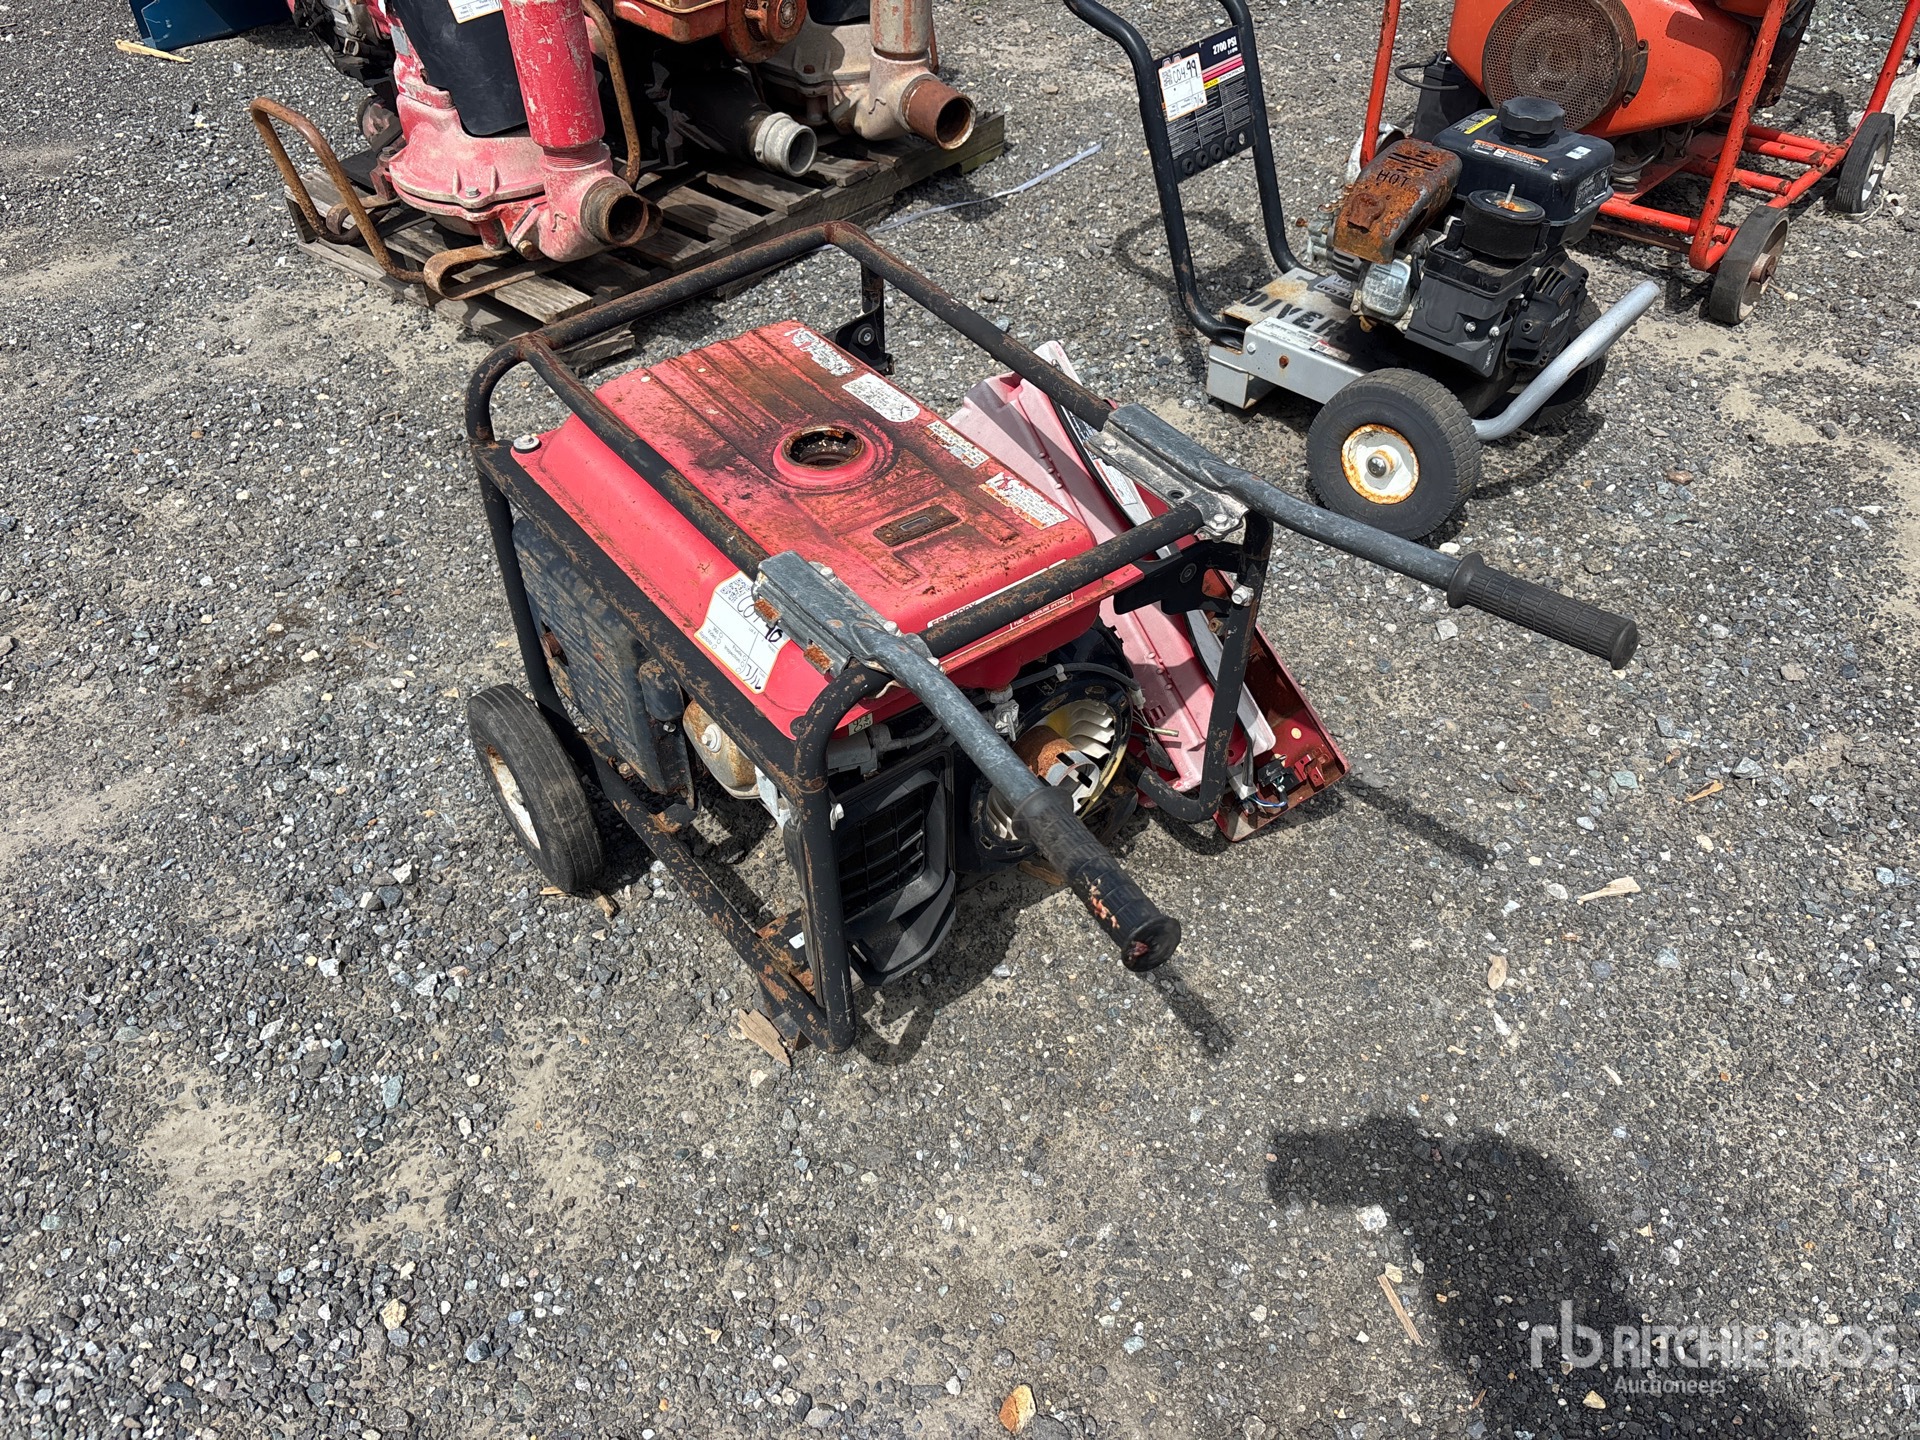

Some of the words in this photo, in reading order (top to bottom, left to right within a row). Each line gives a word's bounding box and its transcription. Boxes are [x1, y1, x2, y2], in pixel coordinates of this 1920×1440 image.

[1212, 41, 1227, 55] 2700
[1227, 36, 1238, 48] PSI
[1376, 169, 1411, 188] HOT
[1013, 618, 1025, 626] FUEL
[1028, 607, 1050, 619] GASOLINE
